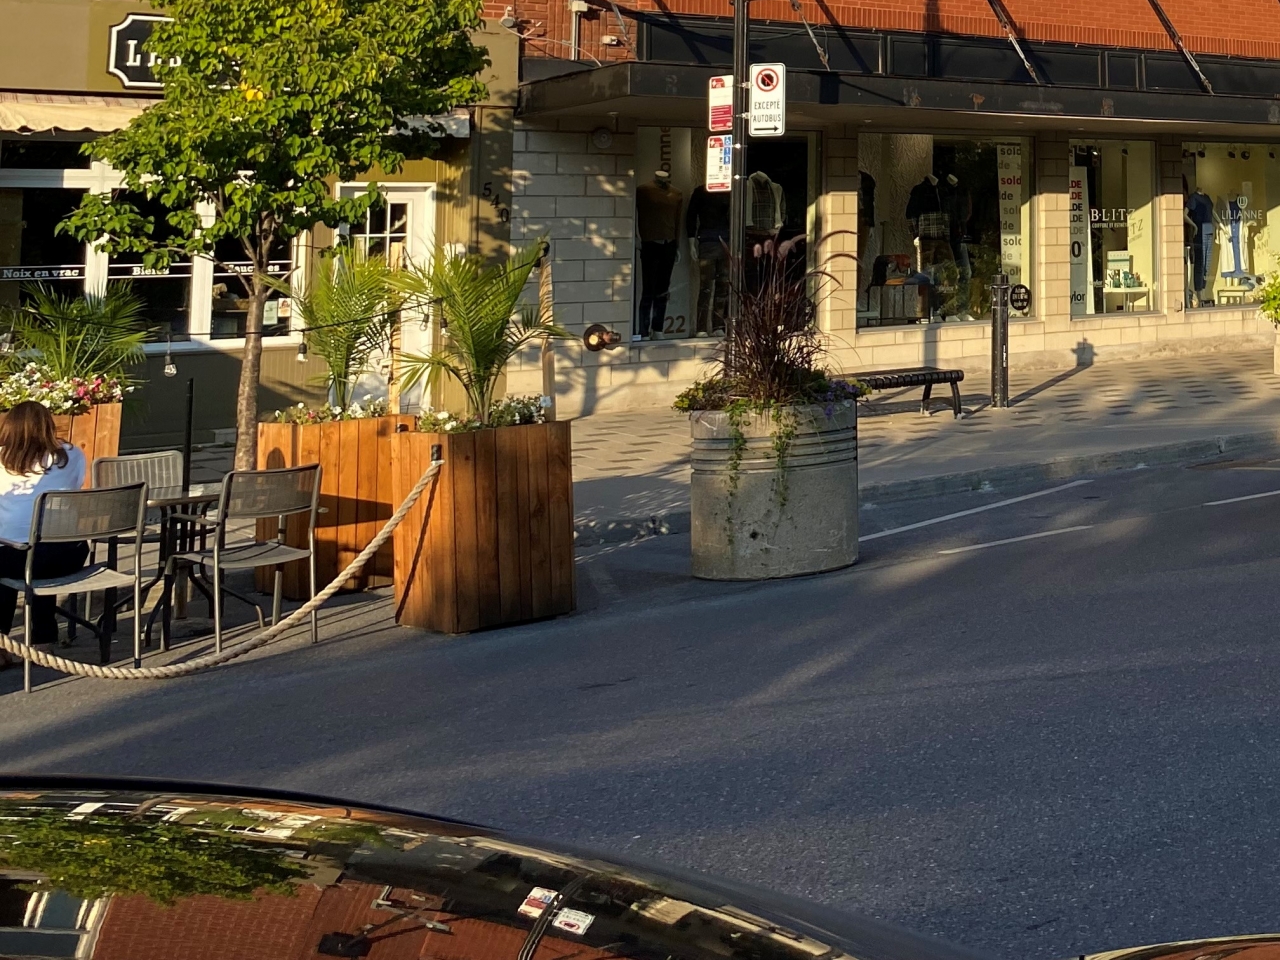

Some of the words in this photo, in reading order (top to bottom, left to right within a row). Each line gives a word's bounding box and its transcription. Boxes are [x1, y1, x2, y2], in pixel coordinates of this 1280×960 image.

[754, 100, 781, 110] EXCEPTÉ
[753, 114, 781, 123] AUTOBUS
[1070, 180, 1082, 189] DE
[1000, 191, 1014, 201] de
[1070, 191, 1083, 200] DE
[482, 181, 510, 223] 540
[1003, 205, 1021, 215] sol
[1221, 209, 1263, 220] LILIANNE
[2, 269, 31, 278] Noix
[34, 270, 49, 278] en
[52, 269, 80, 277] vrac
[664, 314, 687, 334] 22
